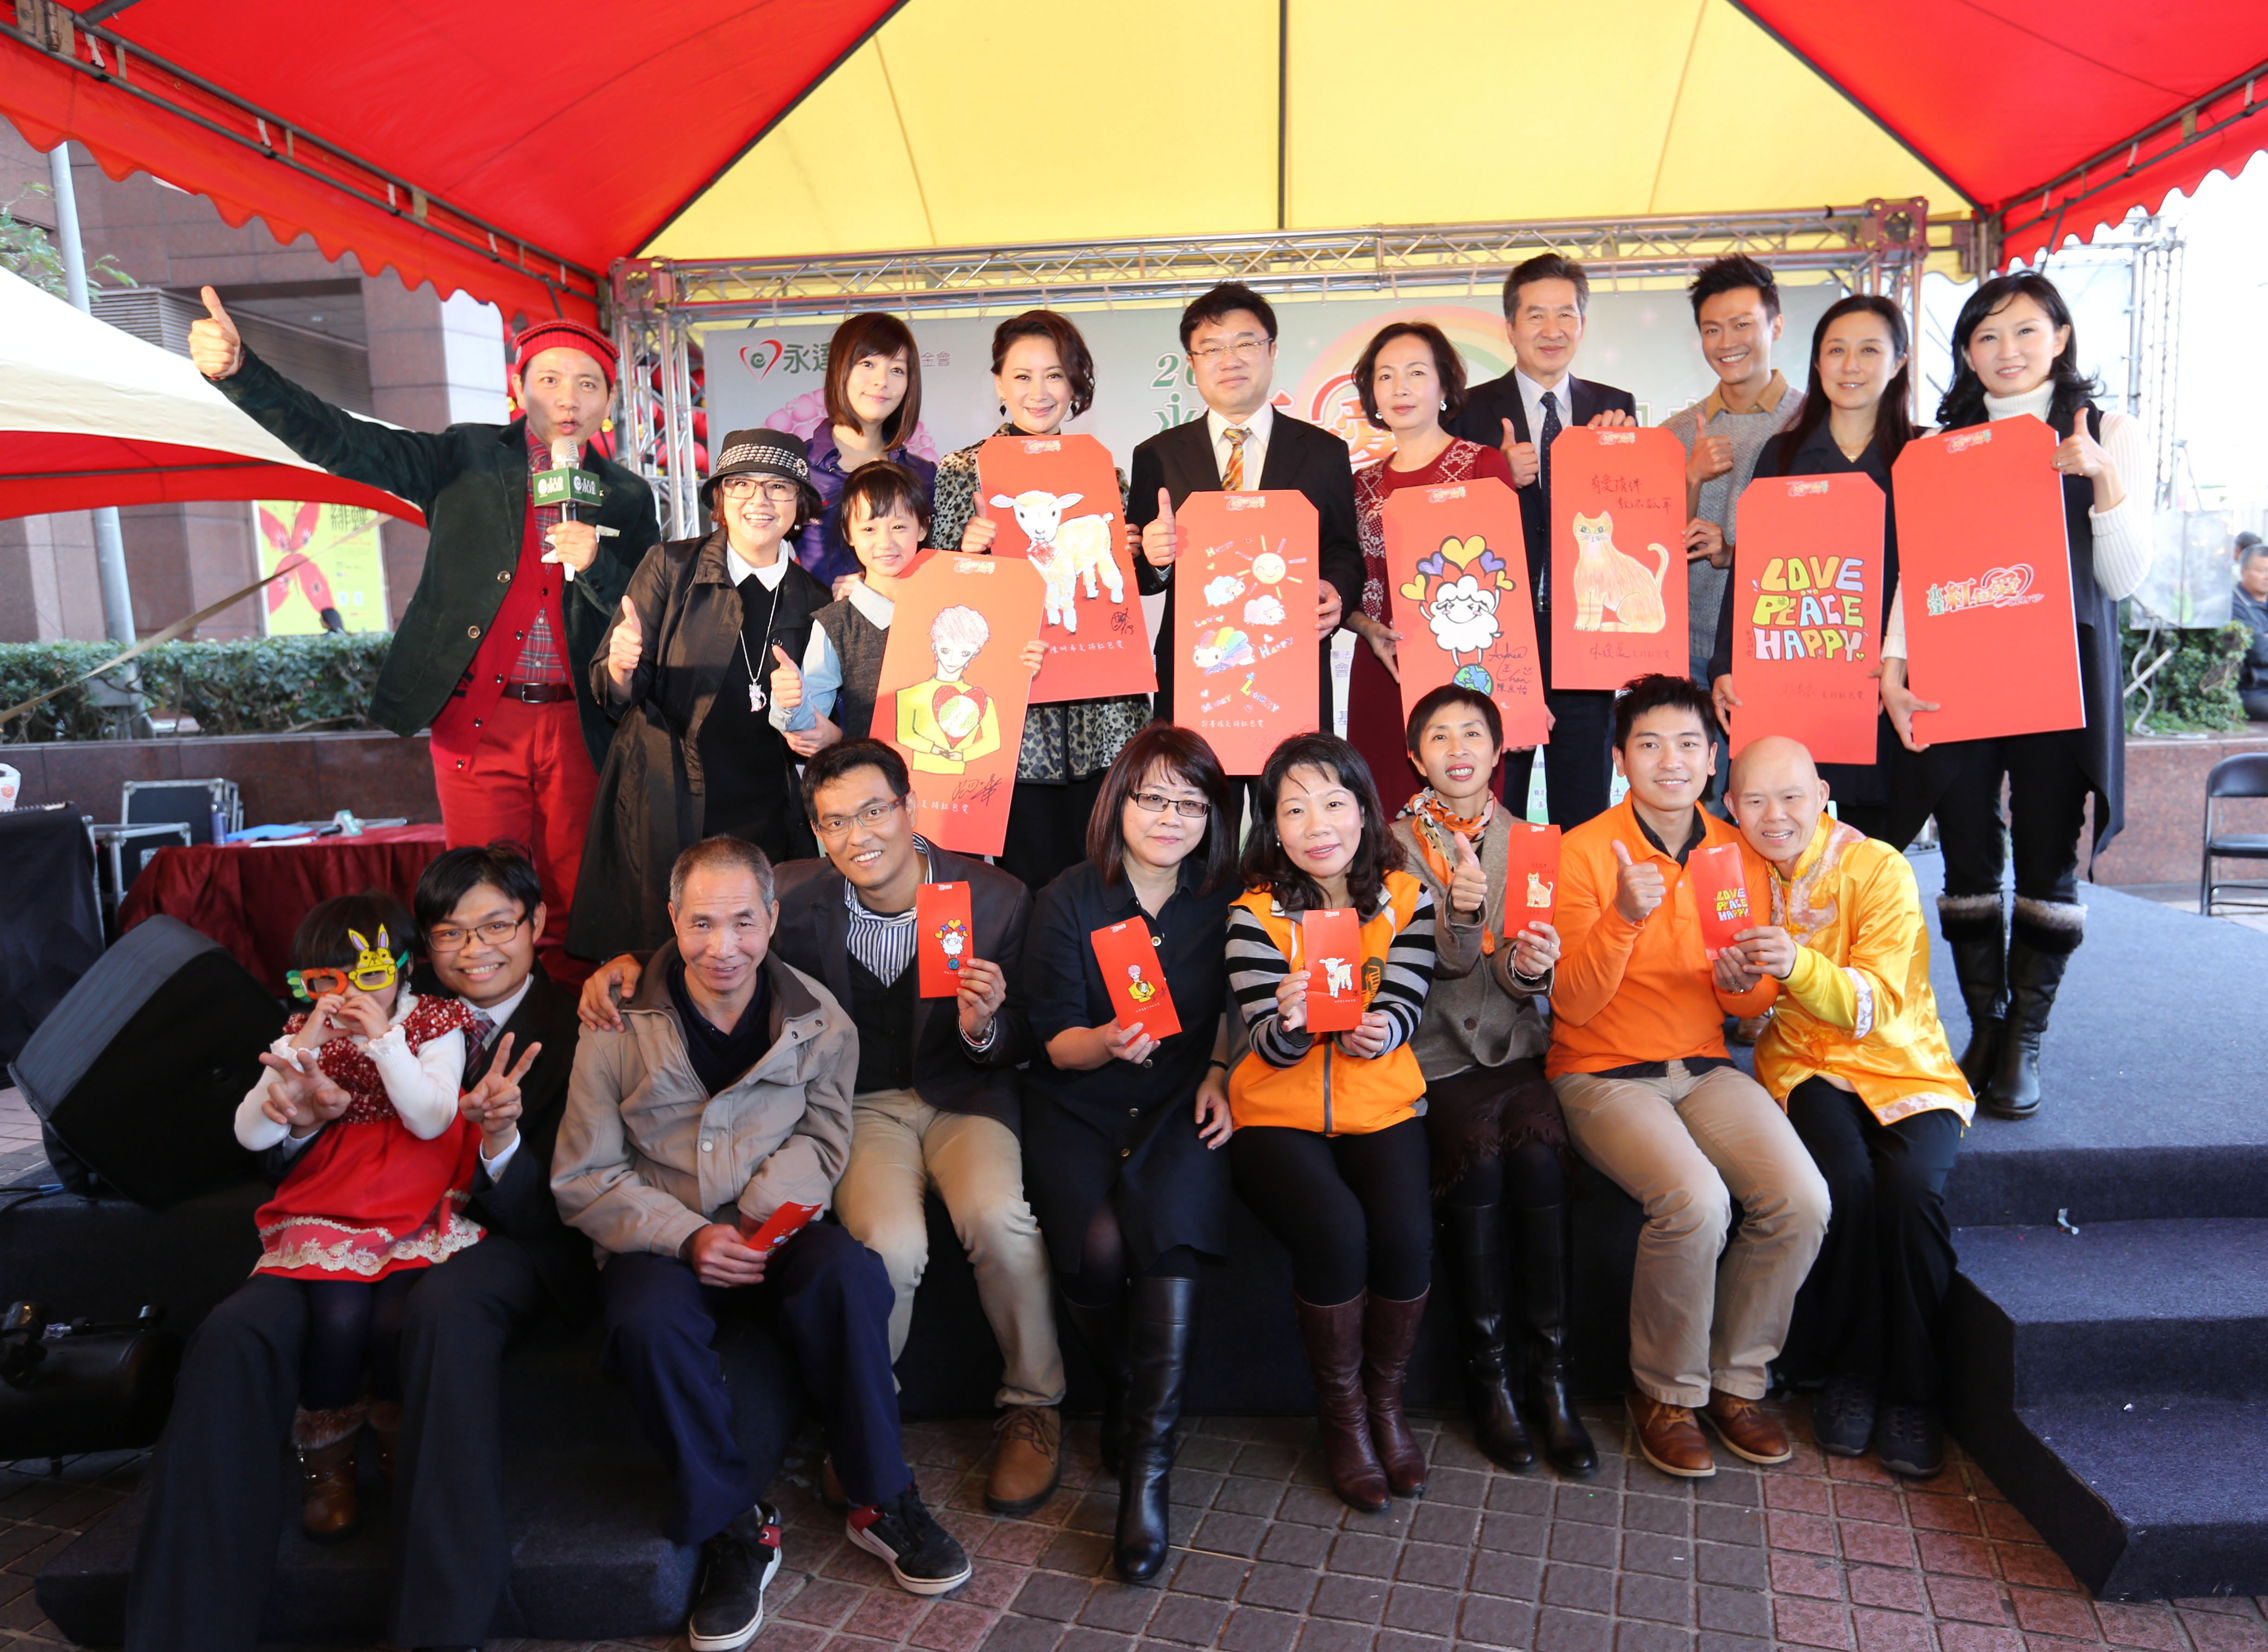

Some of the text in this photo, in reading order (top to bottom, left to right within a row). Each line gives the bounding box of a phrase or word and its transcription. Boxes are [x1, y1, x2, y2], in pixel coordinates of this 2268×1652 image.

[921, 351, 950, 367] 金會
[1760, 555, 1864, 593] LOVE
[1751, 594, 1864, 628] PEACE
[1752, 626, 1863, 662] HAPPY
[1716, 888, 1746, 901] LOVE
[1716, 898, 1748, 912] PEACE
[1717, 908, 1749, 922] HAPPY
